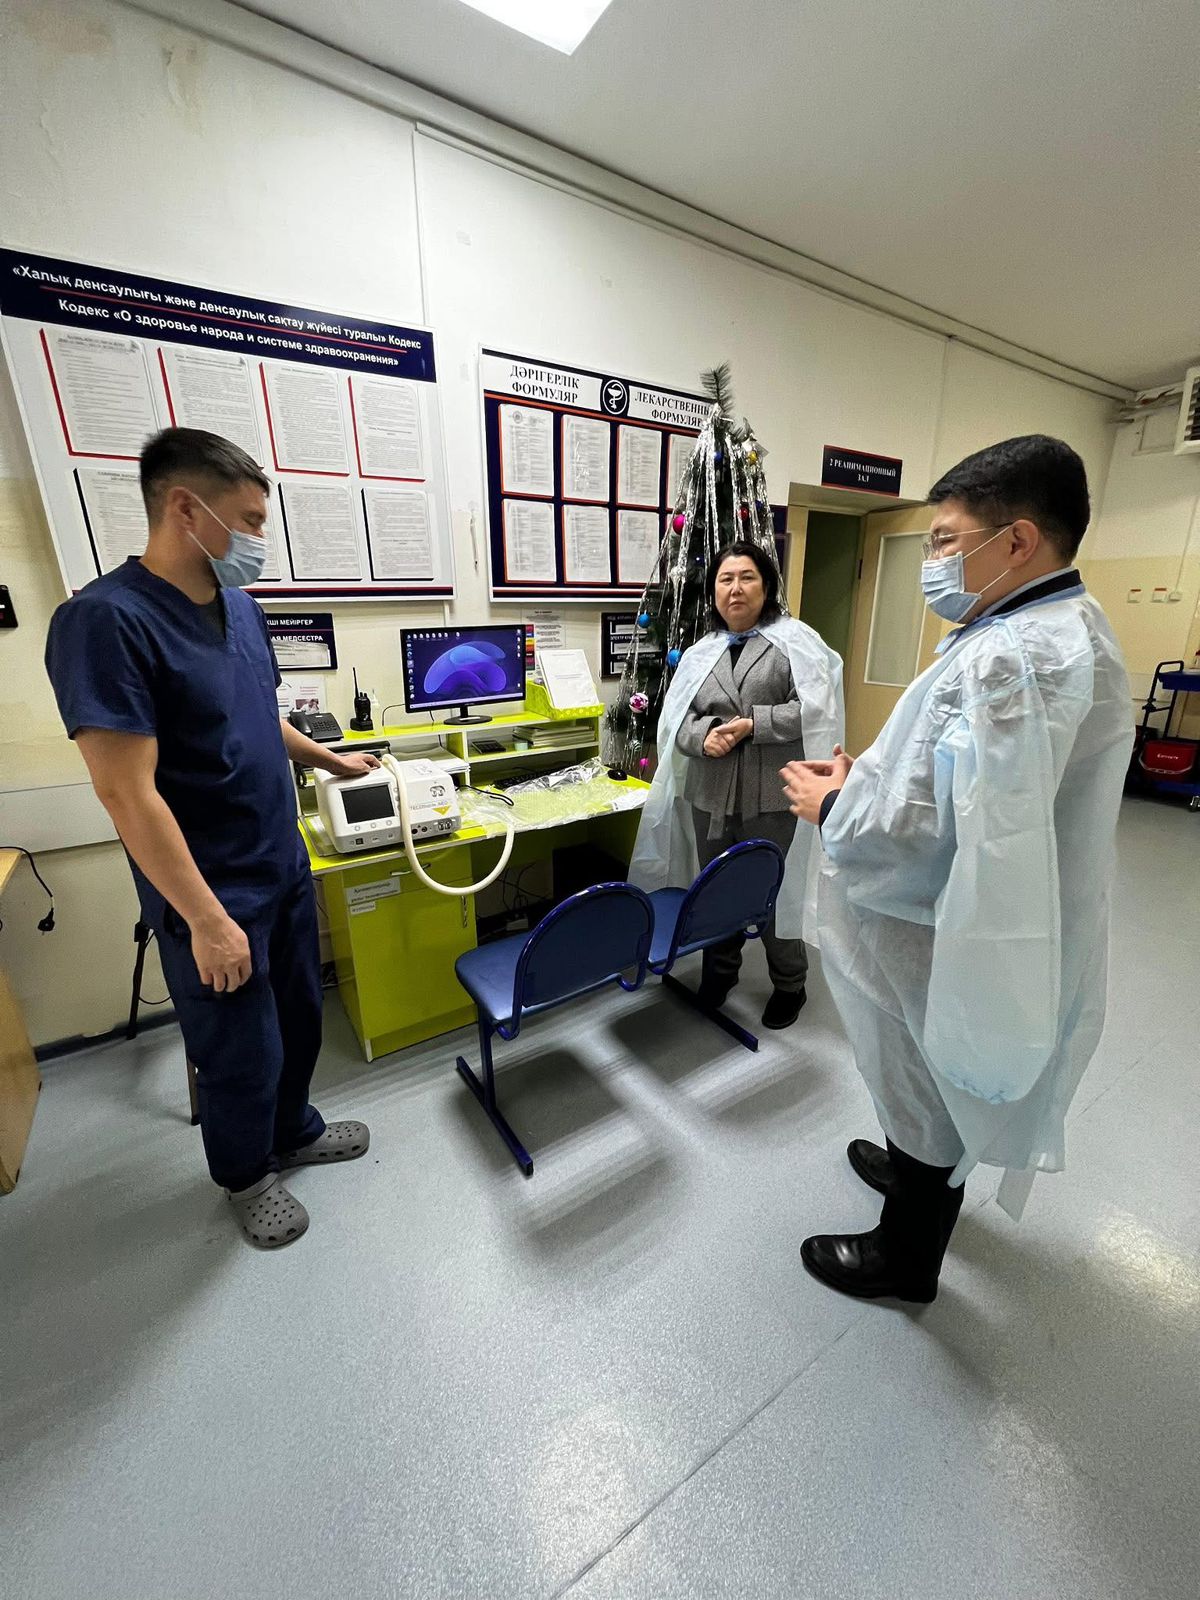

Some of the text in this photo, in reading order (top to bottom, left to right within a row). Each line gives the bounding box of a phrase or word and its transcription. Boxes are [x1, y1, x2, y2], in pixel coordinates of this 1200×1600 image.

[13, 265, 422, 350] «Халық денсаулығы және денсаулық сақтау жүйесі туралы» Кодекс
[58, 298, 399, 366] Кодекс «О здоровье народа и системе здравоохранения»
[509, 364, 580, 389] ДӘРІГЕРЛІК
[511, 381, 578, 404] ФОРМУЛЯР
[634, 391, 711, 416] ЛЕКАРСТВЕННЫ
